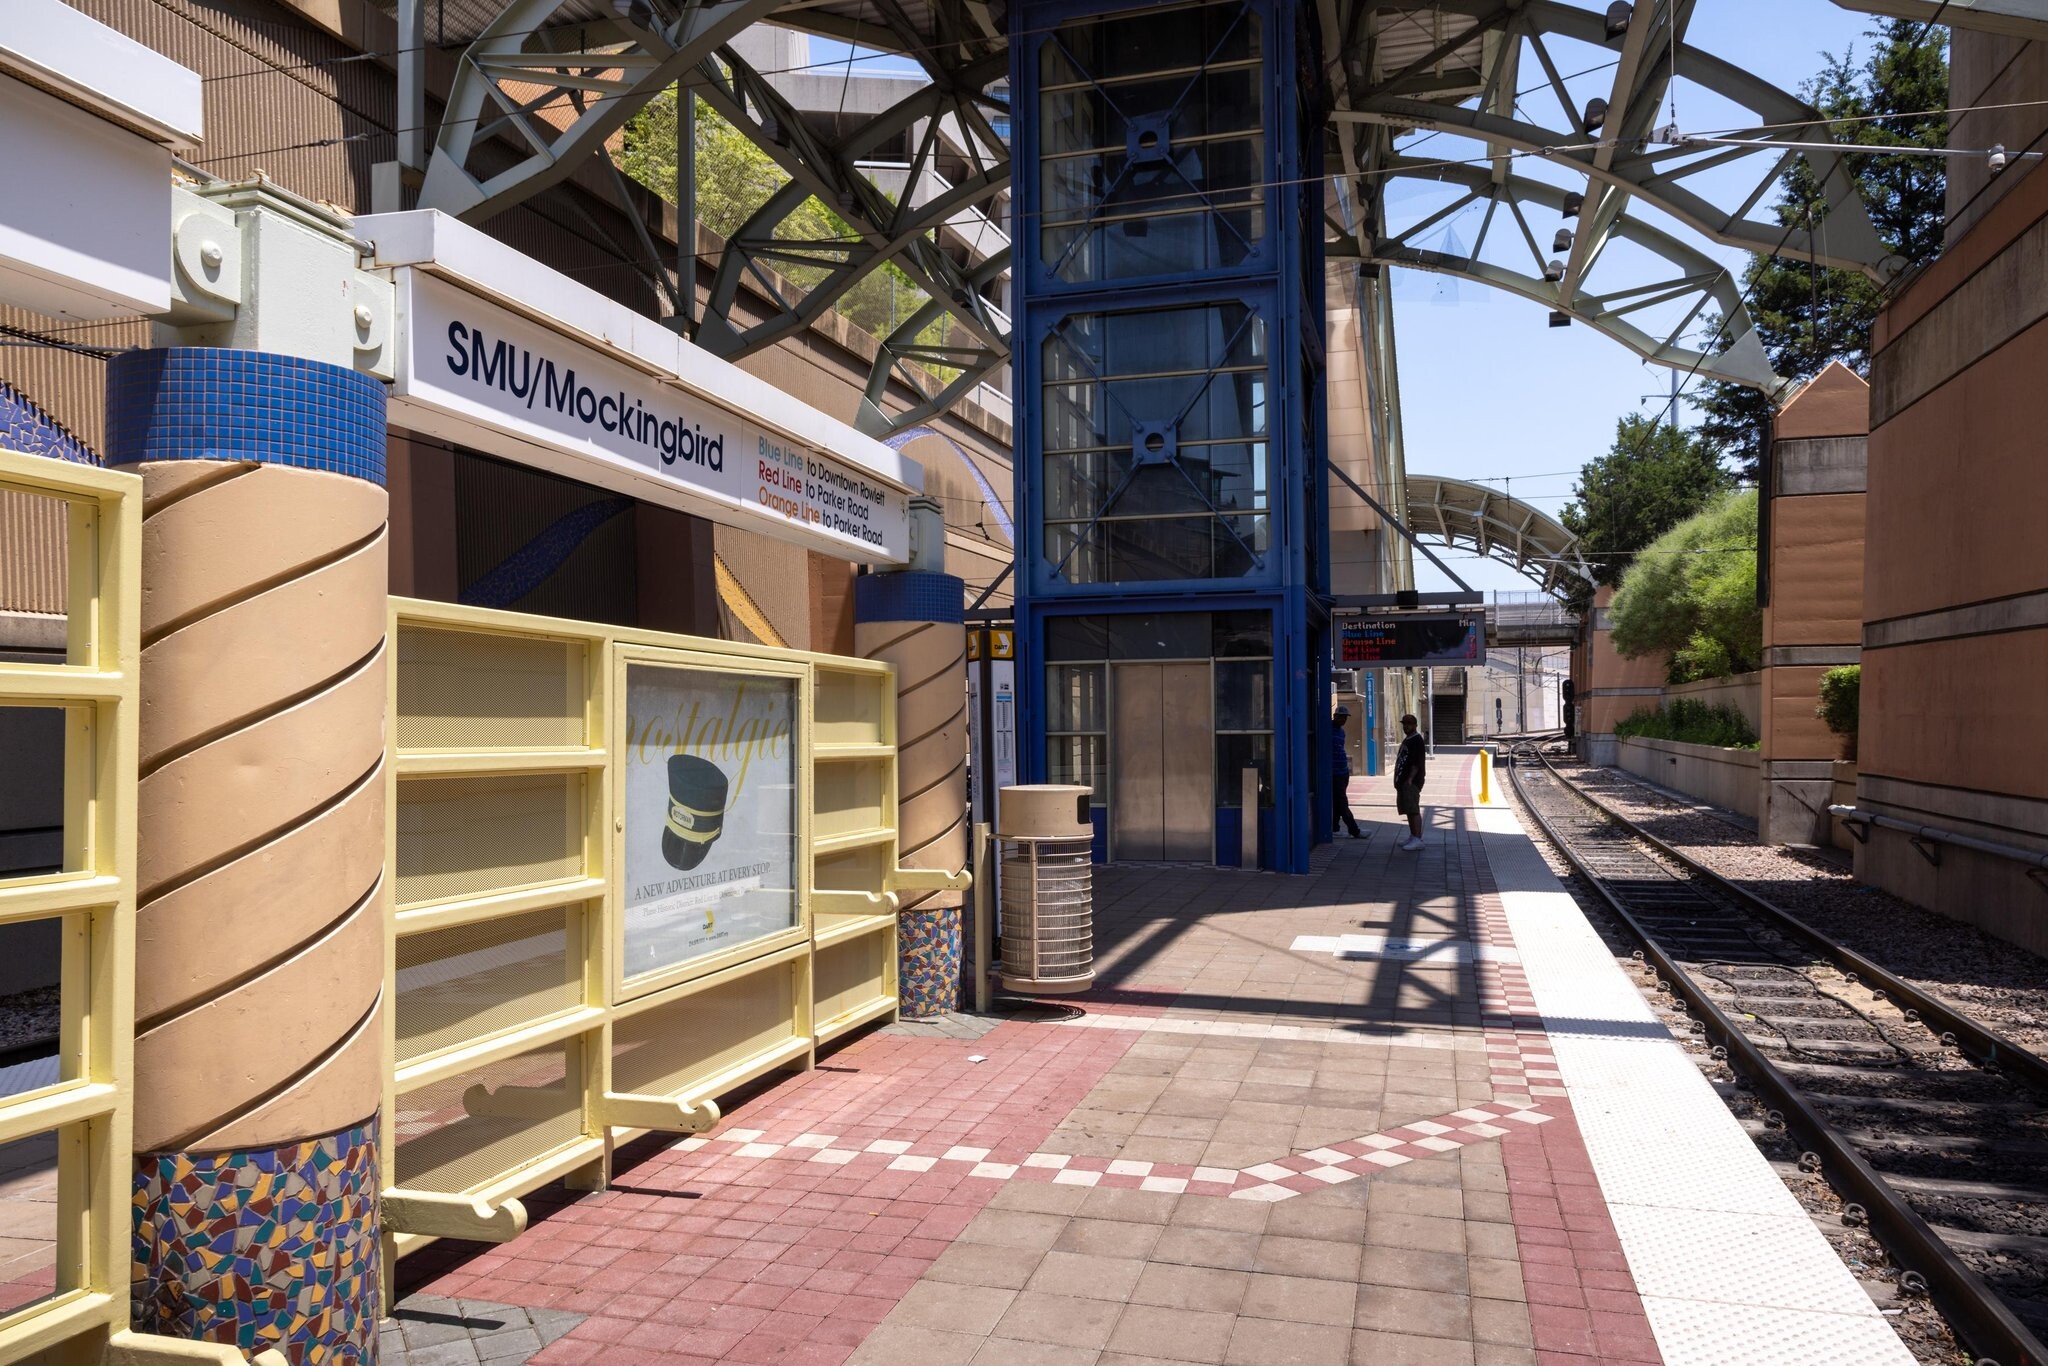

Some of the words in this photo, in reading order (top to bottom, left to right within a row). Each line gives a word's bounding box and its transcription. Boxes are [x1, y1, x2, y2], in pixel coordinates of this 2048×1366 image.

[446, 320, 724, 473] SMU/Mockingbird
[758, 460, 780, 485] Red
[782, 469, 802, 494] Line
[805, 480, 815, 499] to
[817, 484, 846, 511] Parker
[847, 497, 869, 520] Road
[759, 436, 781, 461] Blue
[784, 447, 803, 471] Line
[807, 457, 817, 477] to
[818, 462, 859, 496] Downtown
[860, 481, 885, 506] Rowlett
[759, 486, 799, 519] Orange
[801, 501, 820, 524] Line
[822, 509, 832, 528] to
[833, 514, 861, 538] Parker
[862, 524, 883, 546] Road
[1342, 621, 1396, 630] Destination
[1458, 619, 1476, 627] Min
[635, 887, 641, 900] A
[643, 880, 665, 898] NEW
[666, 872, 716, 894] ADVENTURE
[718, 870, 727, 883] AT
[729, 865, 752, 880] EVERY
